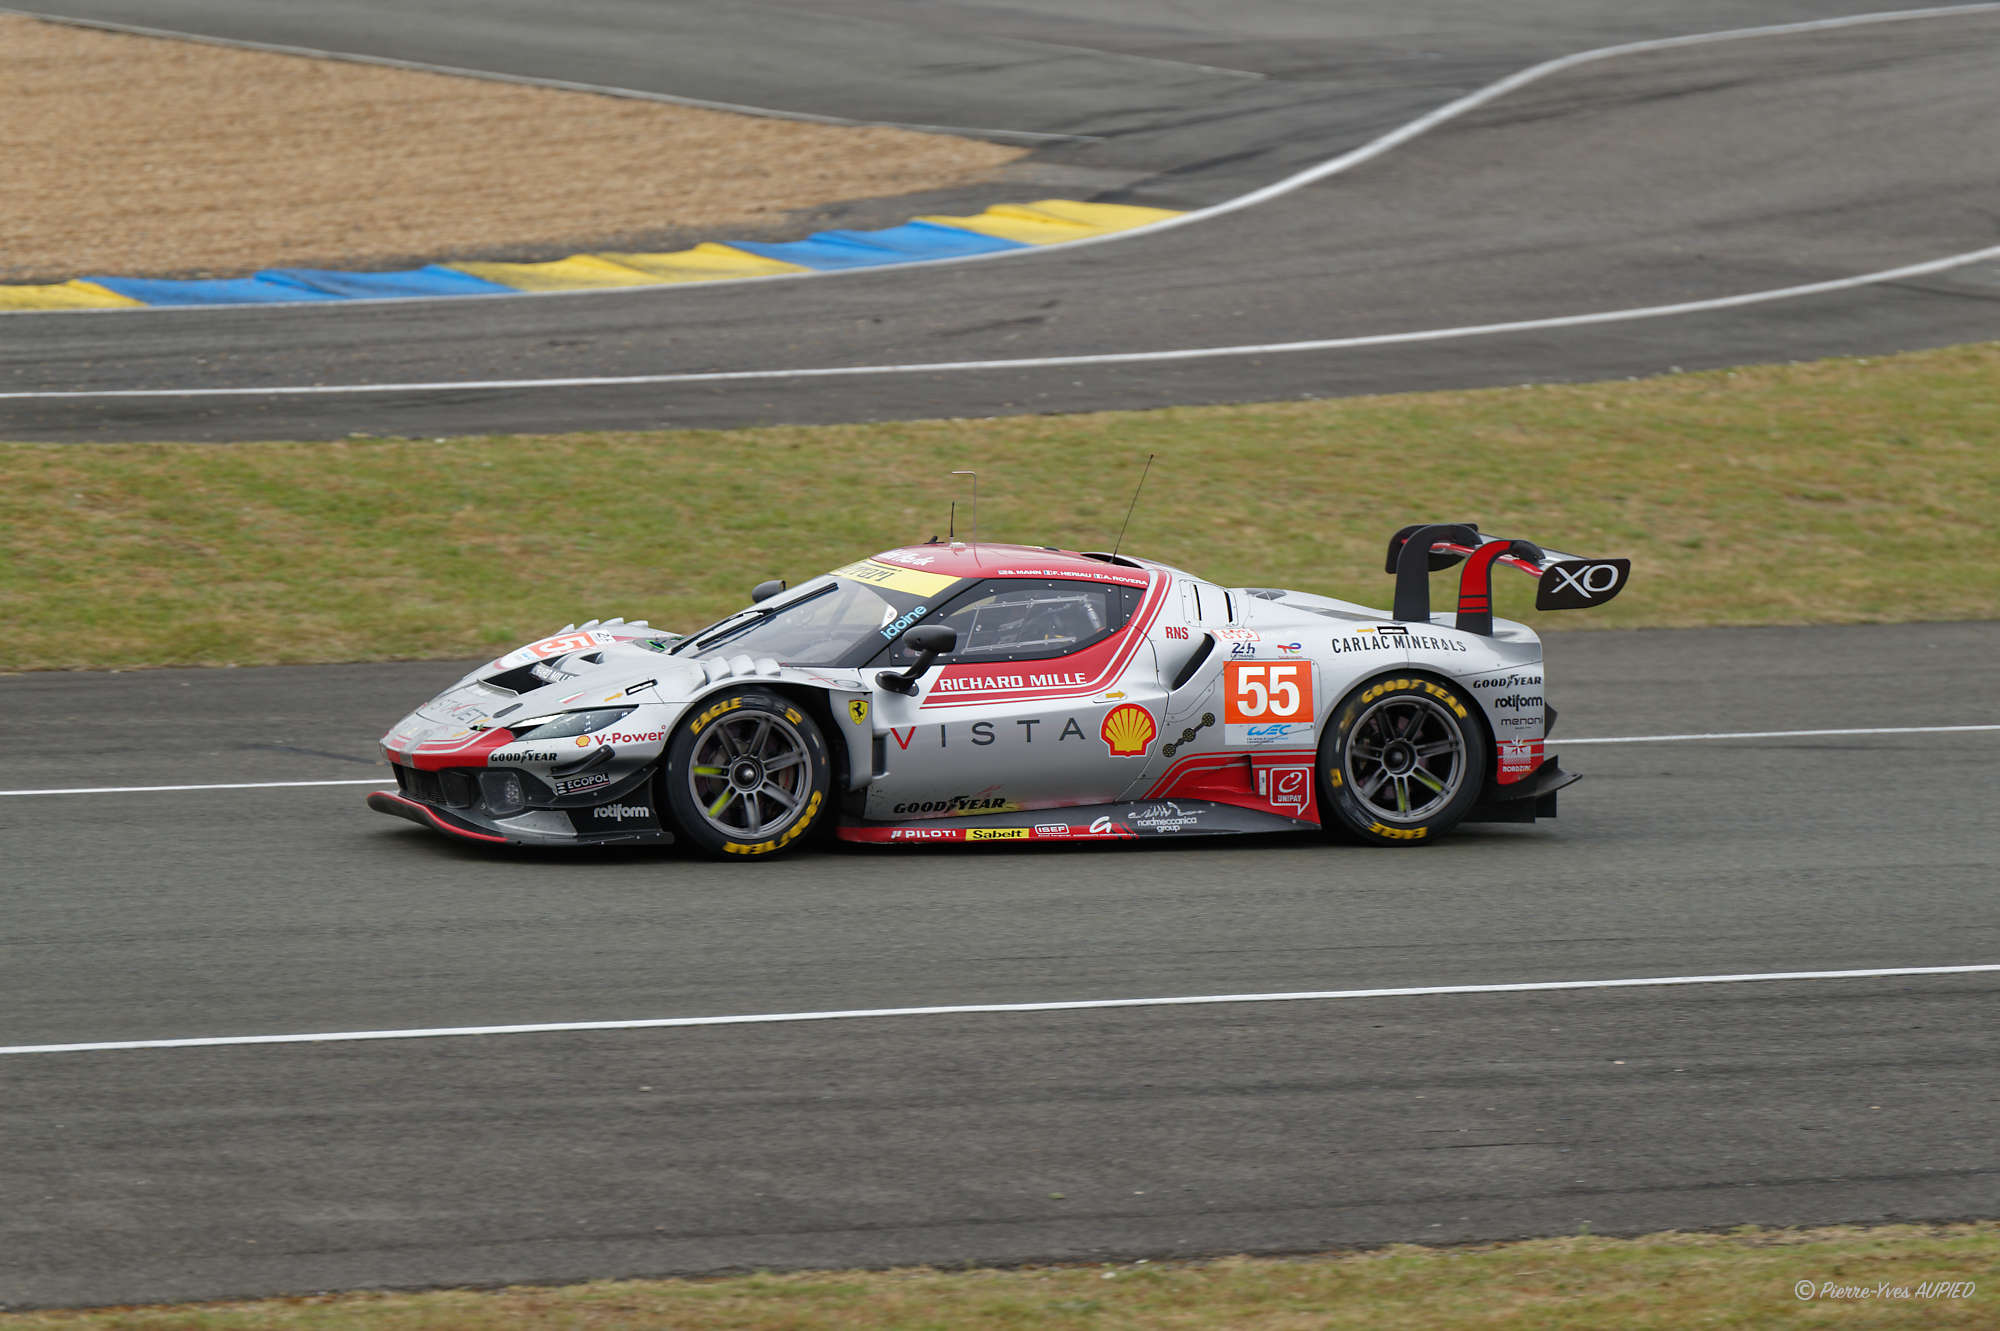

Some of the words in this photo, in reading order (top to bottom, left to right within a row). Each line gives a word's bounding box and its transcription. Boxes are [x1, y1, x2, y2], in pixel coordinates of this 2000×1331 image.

[1112, 576, 1149, 586] ROVERA
[1551, 564, 1619, 599] XO
[880, 605, 927, 640] idoine
[1165, 626, 1189, 640] RNS
[1331, 636, 1390, 654] CARLAC
[1393, 636, 1467, 652] MINERALS
[939, 675, 1023, 691] RICHARD
[1030, 672, 1087, 686] MILLE
[1237, 666, 1300, 717] 55
[1495, 694, 1543, 712] rotiform
[689, 697, 743, 735] EAGLE
[595, 730, 665, 746] V-Power
[890, 717, 1086, 750] VISTA
[1247, 724, 1292, 736] WEC
[567, 773, 610, 790] ECOPOL
[594, 804, 650, 822] rotiform
[1137, 816, 1197, 827] nordmeccanica
[905, 830, 957, 838] PILOTI
[972, 829, 1022, 839] Sabelt
[1156, 824, 1181, 833] group
